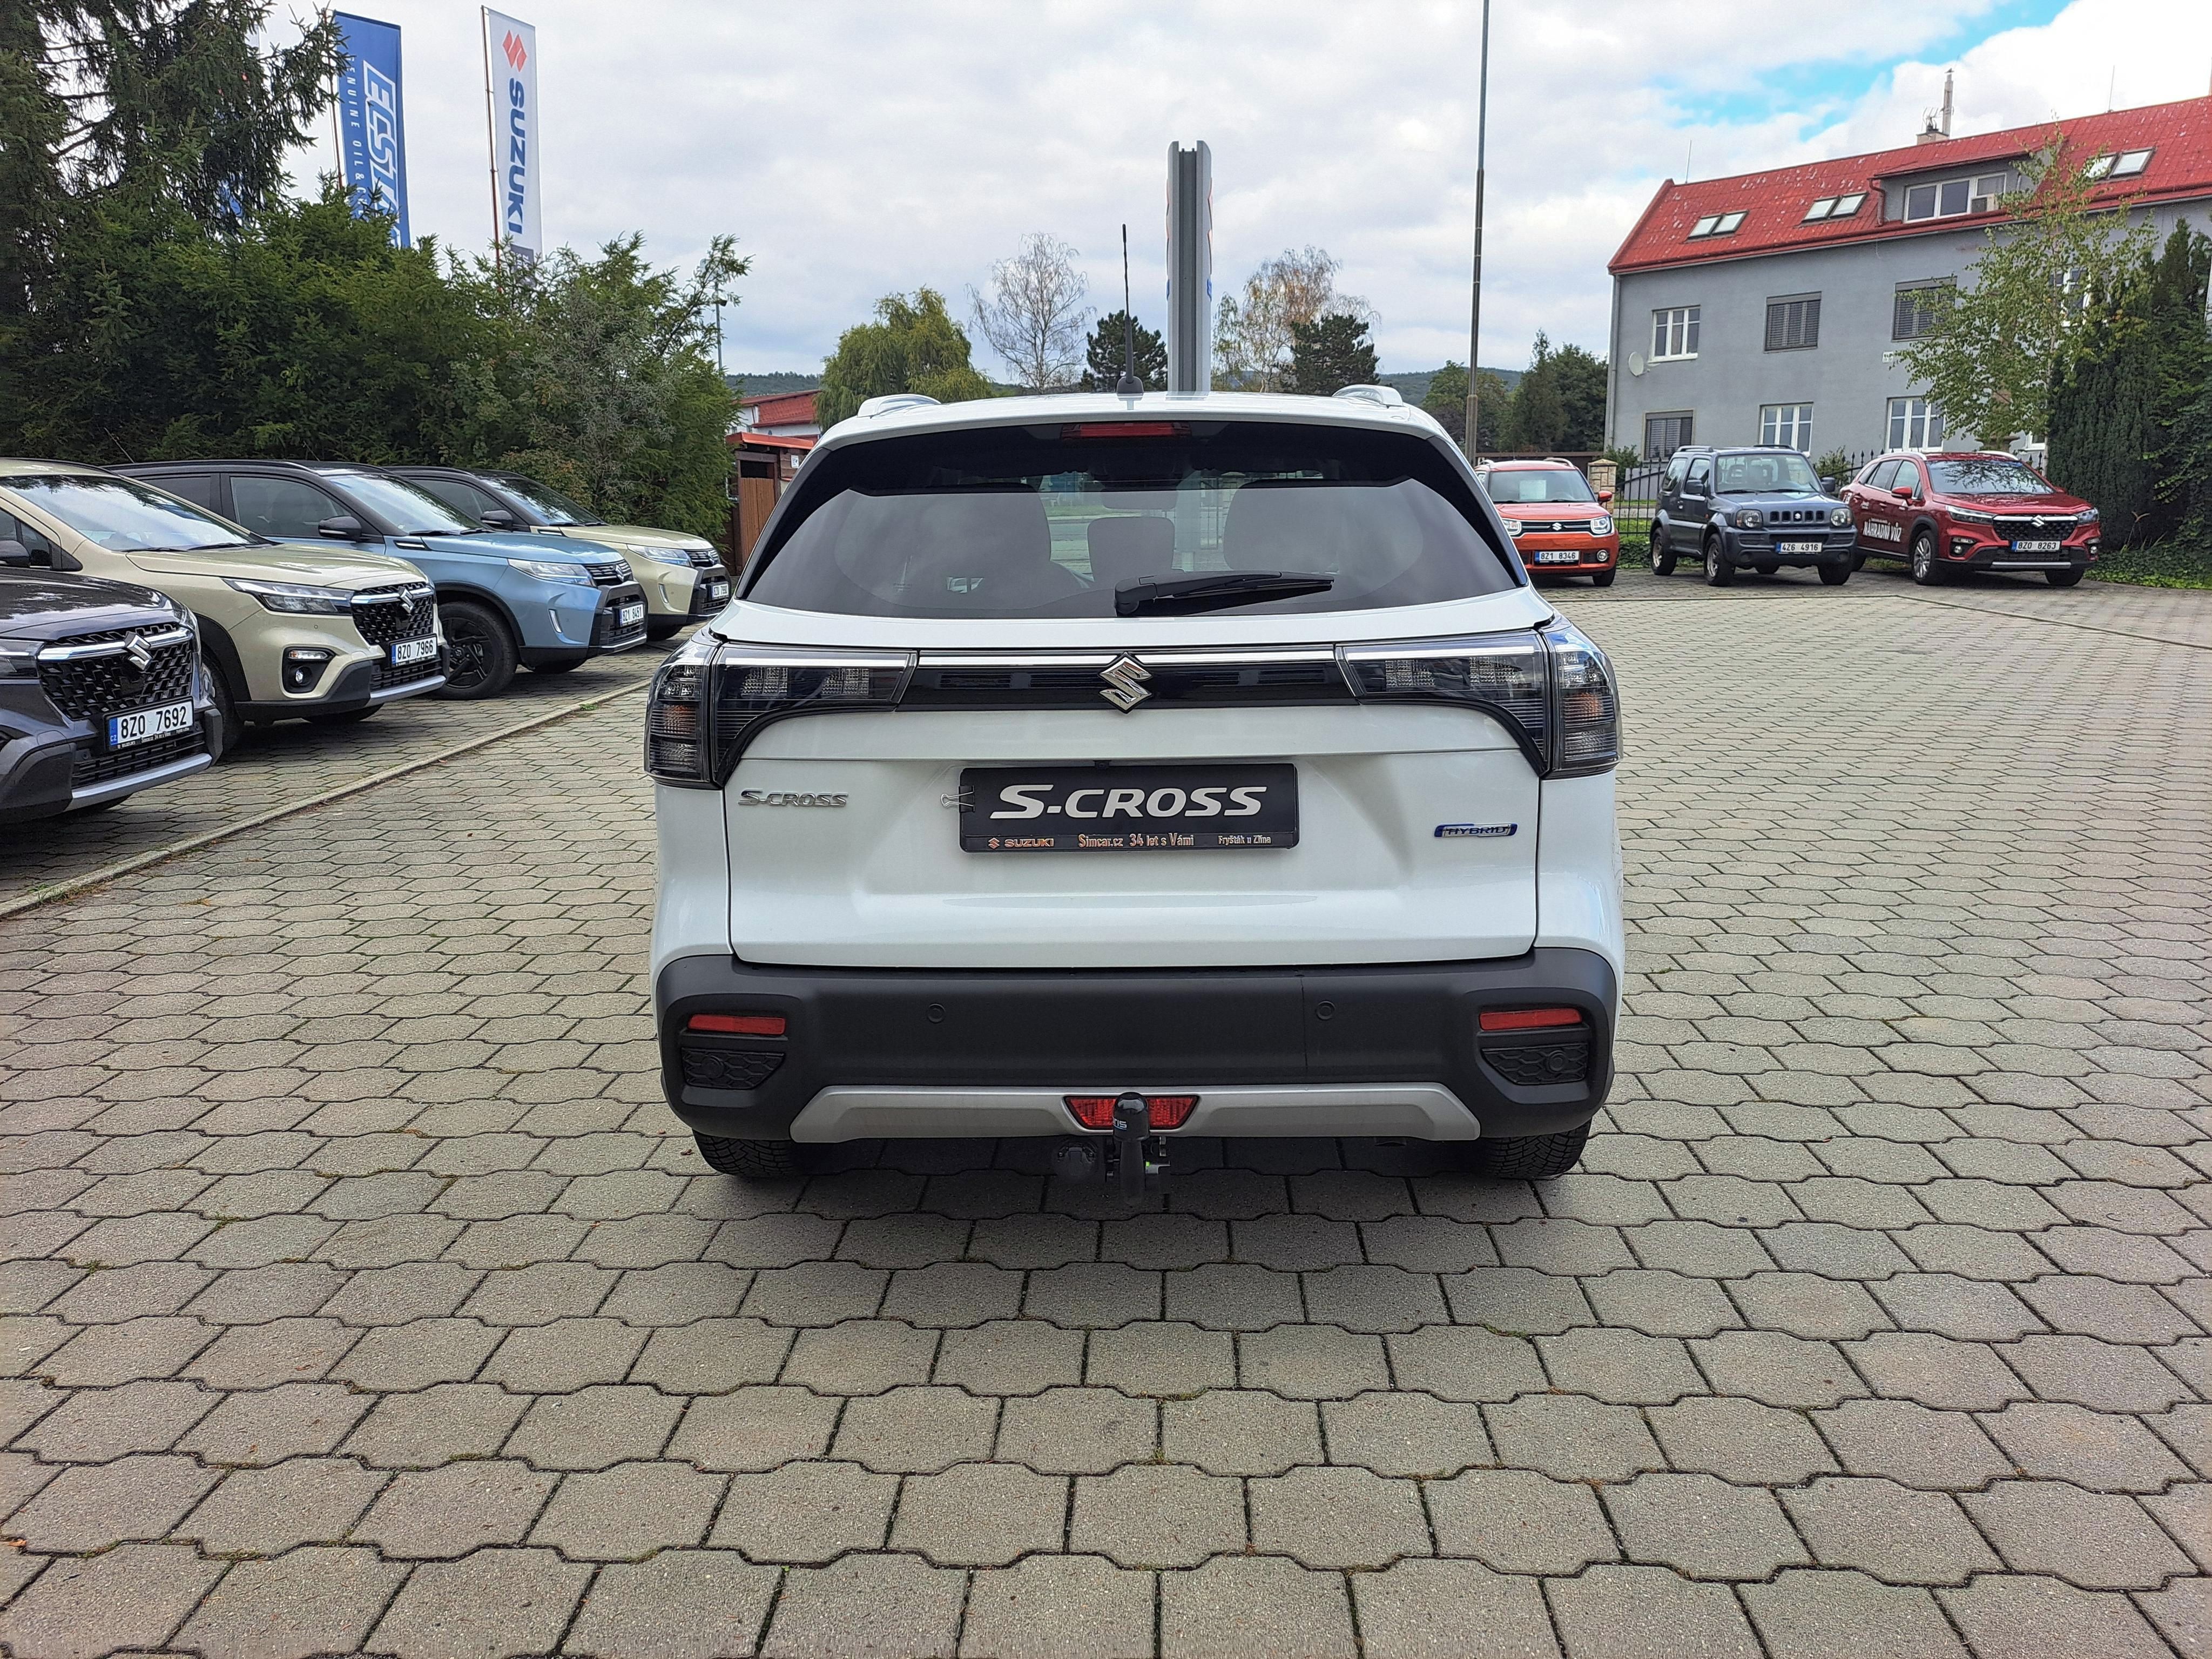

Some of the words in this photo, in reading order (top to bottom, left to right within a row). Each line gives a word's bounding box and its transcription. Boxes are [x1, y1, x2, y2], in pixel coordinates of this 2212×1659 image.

[353, 141, 364, 166] OIL
[508, 77, 525, 234] SUZUKI
[355, 172, 365, 180] &
[1863, 519, 1890, 540] NÁHRADNÍ
[397, 644, 411, 660] 8Z0
[416, 639, 433, 656] 7966
[121, 714, 145, 739] 8Z0
[156, 706, 187, 732] 7692
[738, 788, 848, 807] S-CROSS
[989, 784, 1268, 820] S-CROSS
[1078, 834, 1123, 848] Simcar.cz
[1129, 833, 1144, 847] 34
[1146, 835, 1159, 846] let
[1161, 837, 1167, 846] s
[1168, 833, 1194, 846] Vámi
[1218, 835, 1245, 845] Fryšták
[1448, 826, 1506, 835] HYBRID
[1004, 838, 1054, 848] SUZUKI
